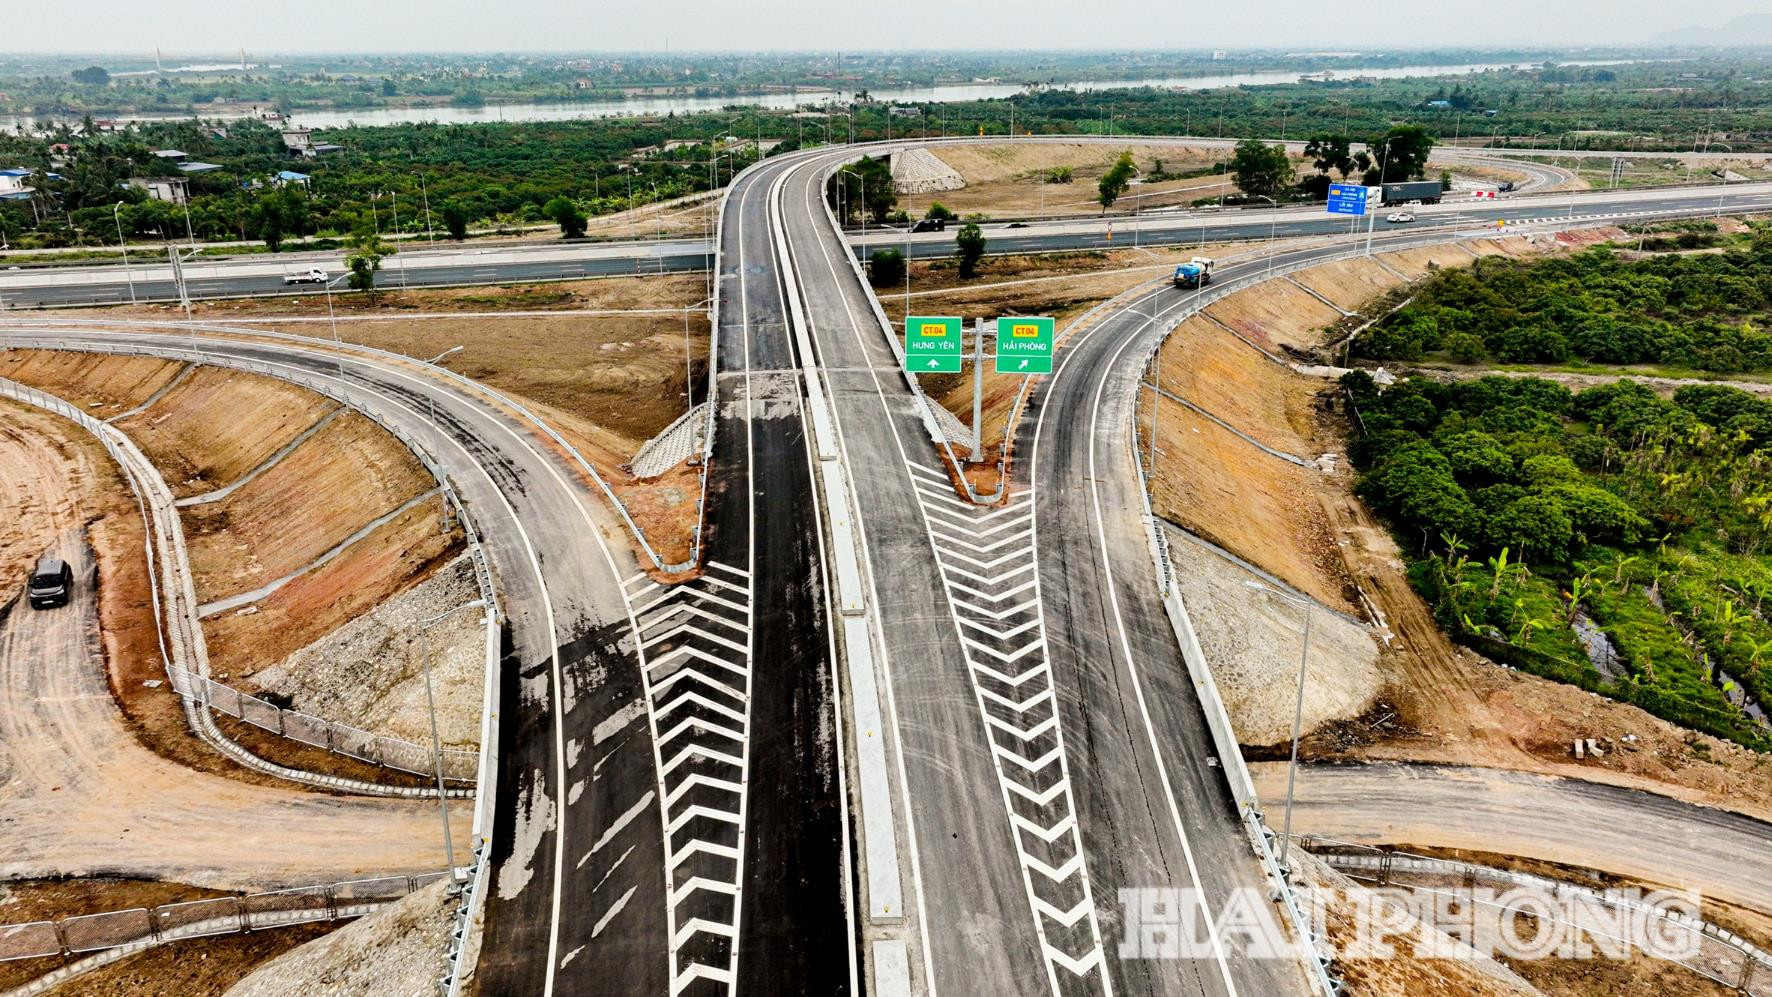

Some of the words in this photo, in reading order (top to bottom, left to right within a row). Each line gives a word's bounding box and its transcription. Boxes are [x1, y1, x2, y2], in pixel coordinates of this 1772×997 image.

[938, 341, 954, 350] YÊN
[1003, 340, 1017, 350] HẢI
[1018, 341, 1047, 351] PHÒNG
